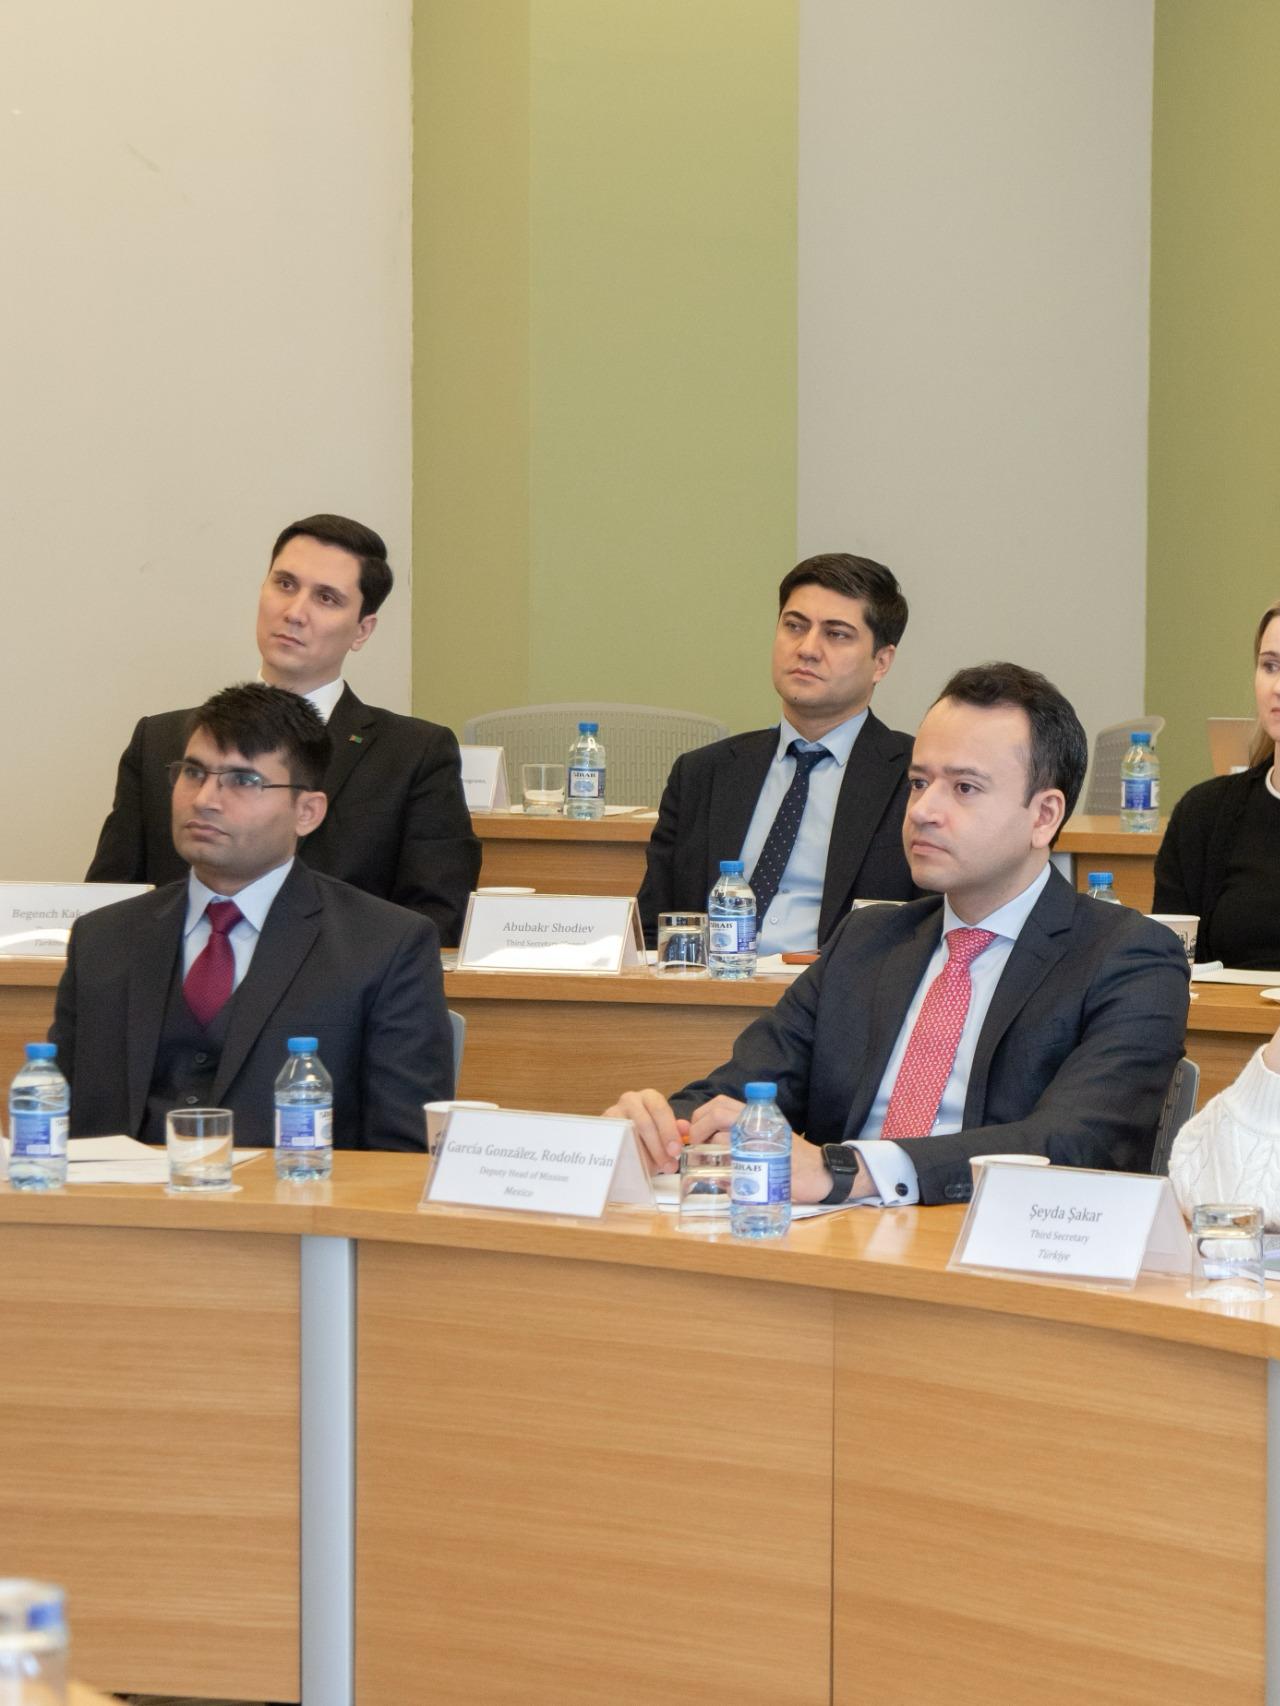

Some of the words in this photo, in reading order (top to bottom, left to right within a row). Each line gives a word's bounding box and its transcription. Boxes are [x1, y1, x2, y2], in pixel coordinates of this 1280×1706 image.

[12, 908, 58, 920] Begench
[502, 922, 550, 933] Abubakr
[551, 923, 595, 934] Shodiev
[447, 1141, 483, 1154] García
[541, 1150, 586, 1164] Rodolfo
[588, 1153, 614, 1167] Iván
[479, 1166, 507, 1178] Deputy
[507, 1169, 529, 1179] Head
[530, 1171, 539, 1180] of
[504, 1186, 534, 1197] Mexico
[1029, 1203, 1065, 1221] Şeyda
[1067, 1206, 1103, 1223] Şakar
[1030, 1229, 1052, 1241] Third
[1053, 1231, 1090, 1245] Secretary
